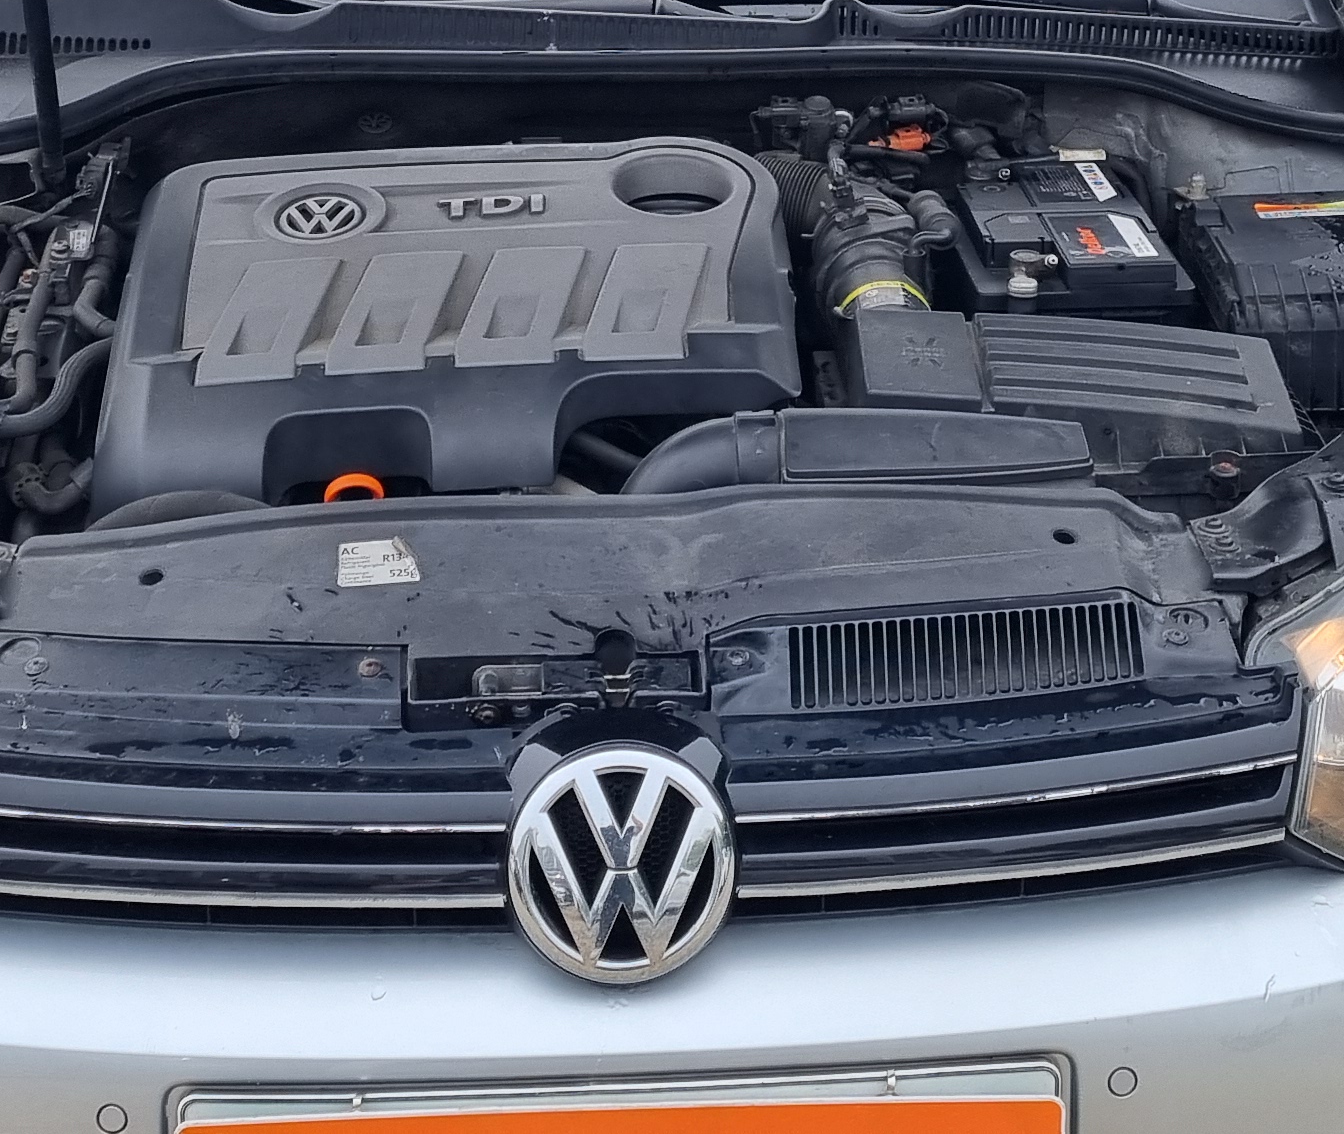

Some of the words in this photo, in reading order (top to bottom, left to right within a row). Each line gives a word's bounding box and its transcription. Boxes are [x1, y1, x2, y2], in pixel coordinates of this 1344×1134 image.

[278, 195, 362, 238] VW
[437, 193, 546, 219] TDI
[341, 546, 359, 556] AC
[511, 746, 733, 982] VW
